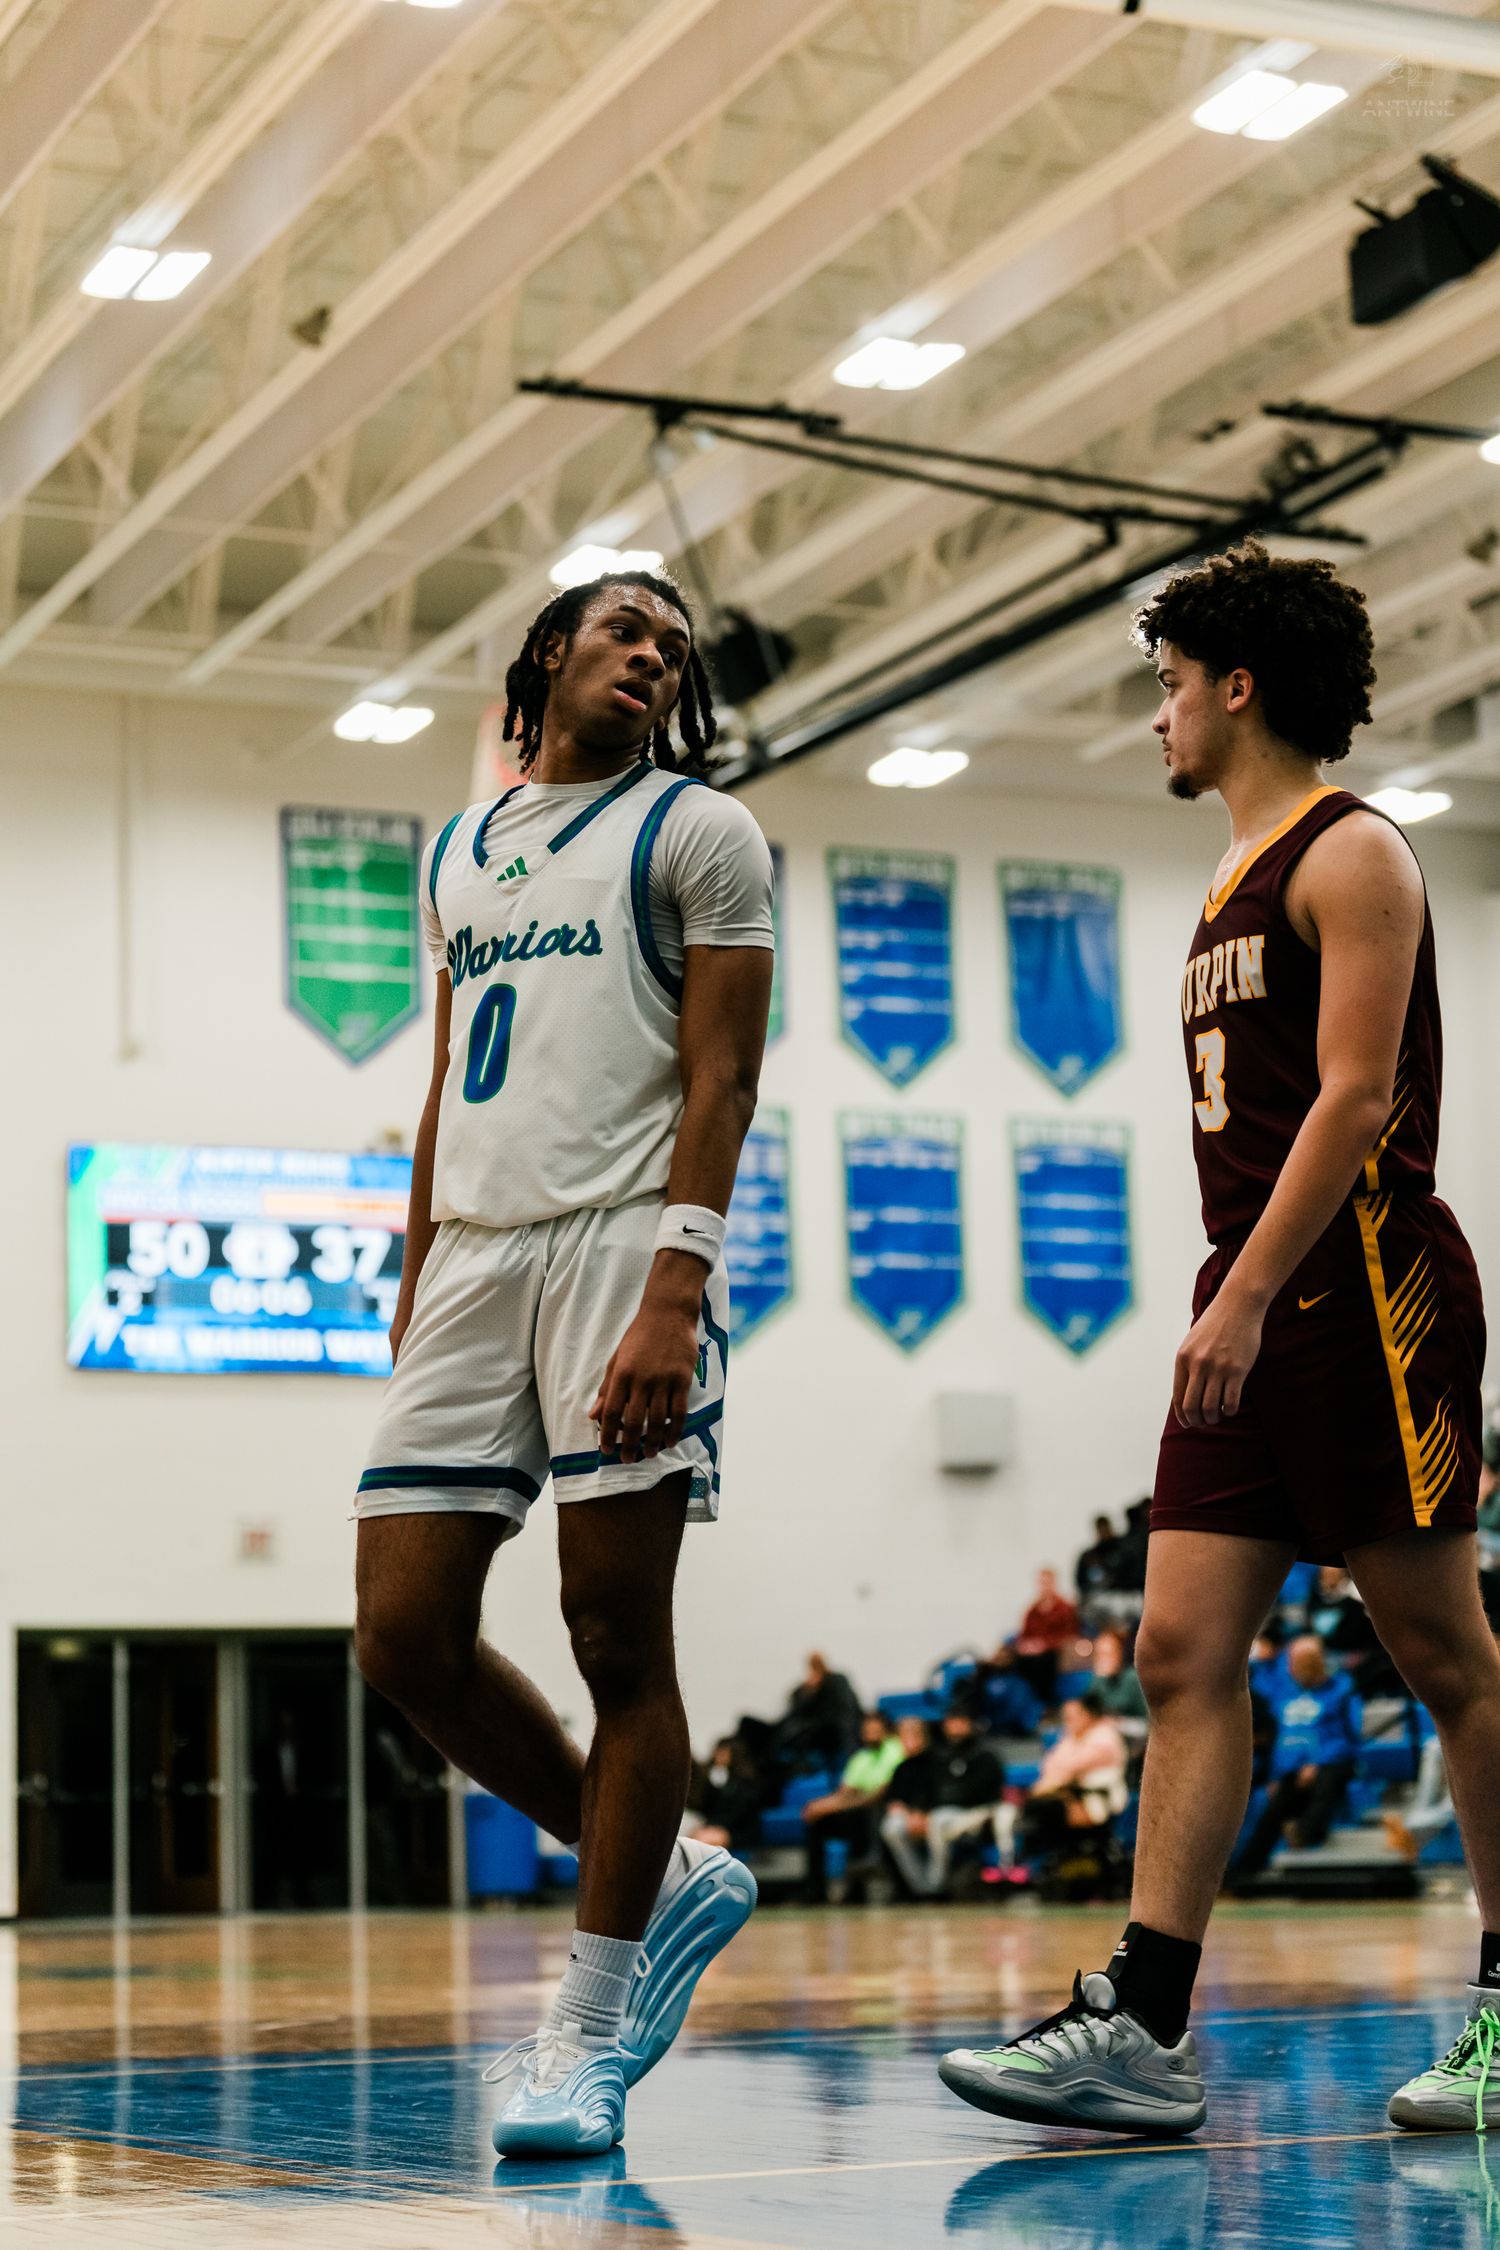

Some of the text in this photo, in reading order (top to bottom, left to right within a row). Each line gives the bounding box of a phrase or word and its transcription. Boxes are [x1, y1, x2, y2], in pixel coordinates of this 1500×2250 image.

[447, 918, 604, 991] Warriors
[1182, 934, 1268, 1024] URPIN
[463, 982, 518, 1104] 0
[1193, 1026, 1231, 1133] 3
[127, 1220, 210, 1279] 50
[311, 1224, 391, 1284] 37
